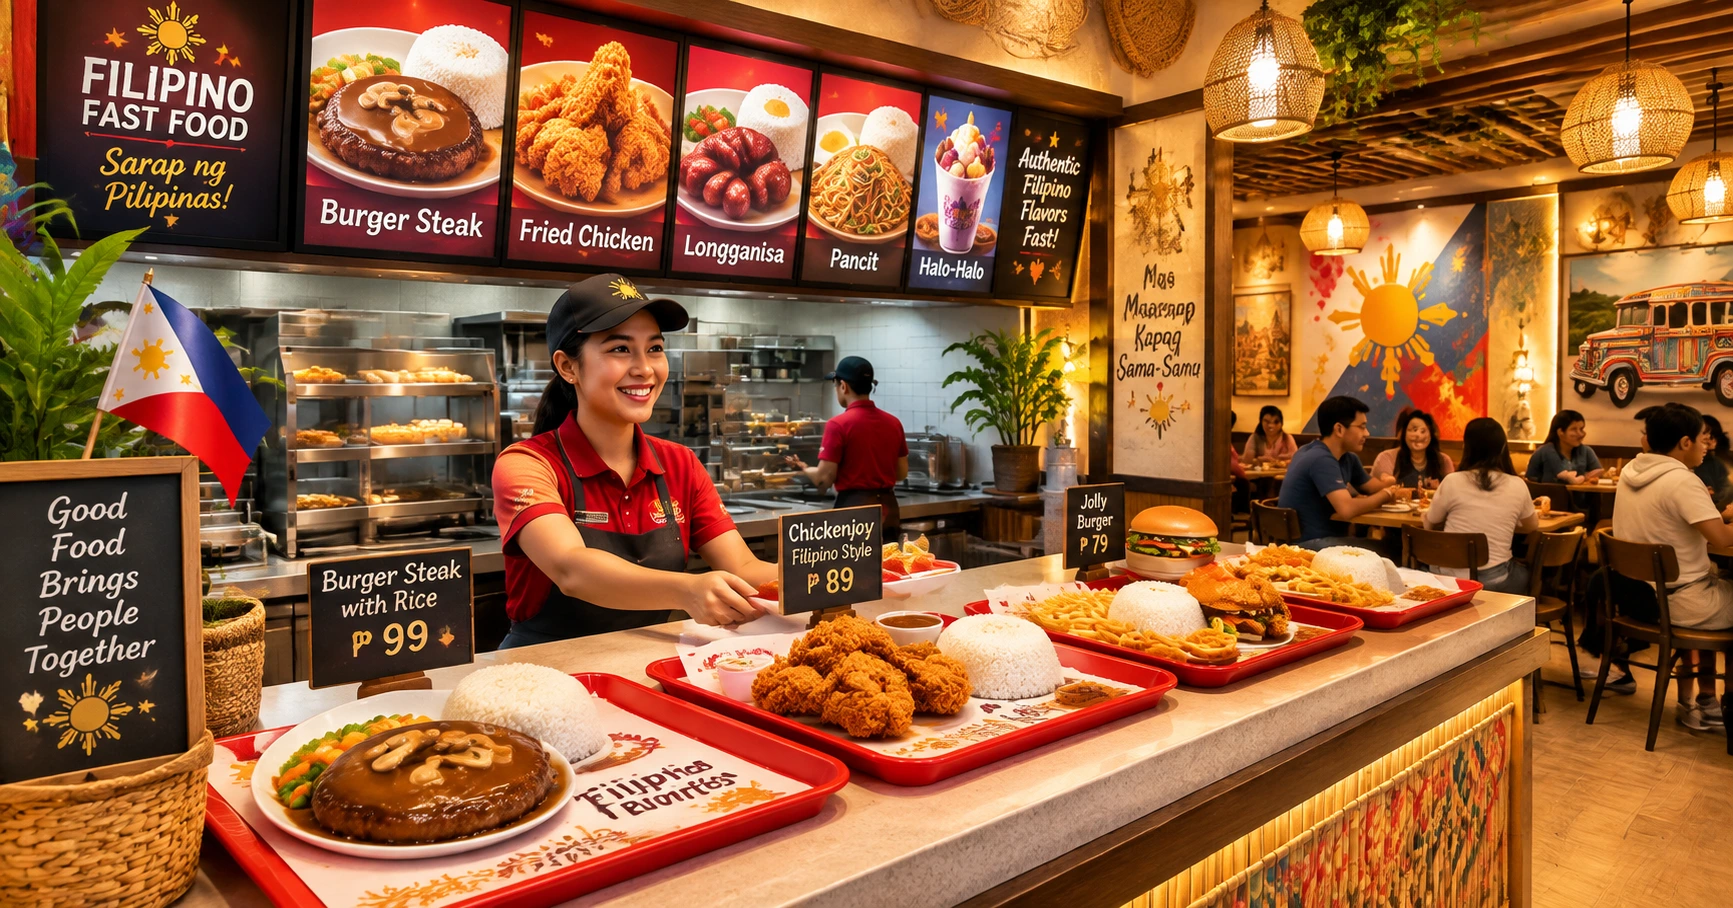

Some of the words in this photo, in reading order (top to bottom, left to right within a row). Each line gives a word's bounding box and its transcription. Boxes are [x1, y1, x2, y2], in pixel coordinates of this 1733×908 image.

[82, 56, 254, 113] FILIPINO
[82, 99, 159, 131] FAST
[168, 109, 249, 142] FOOD
[100, 147, 186, 184] Sarap
[193, 160, 226, 187] ng
[1018, 147, 1081, 176] Authentic
[104, 181, 234, 218] Pilipinas!
[1023, 174, 1072, 204] Filipino
[320, 198, 410, 236] Burger
[415, 208, 484, 238] Steak
[1020, 200, 1068, 223] Flavors
[519, 219, 574, 246] Fried
[578, 224, 654, 252] Chicken
[683, 235, 785, 266] Longganisa
[1022, 226, 1060, 249] Fast!
[829, 249, 880, 272] Pancit
[919, 256, 985, 281] Halo-Halo
[47, 491, 128, 530] Good
[1080, 492, 1108, 512] Jolly
[788, 518, 875, 543] Chickenjoy
[1076, 514, 1114, 532] Burger
[51, 527, 126, 562] Food
[791, 548, 839, 568] Filipino
[841, 542, 873, 562] Style
[1092, 533, 1109, 555] 79
[39, 568, 139, 599] Brings
[321, 569, 399, 595] Burger
[403, 558, 463, 585] Steak
[825, 566, 855, 594] 89
[38, 598, 139, 638] People
[341, 593, 388, 619] with
[393, 589, 438, 613] Rice
[382, 619, 429, 656] 99
[24, 634, 156, 678] Together
